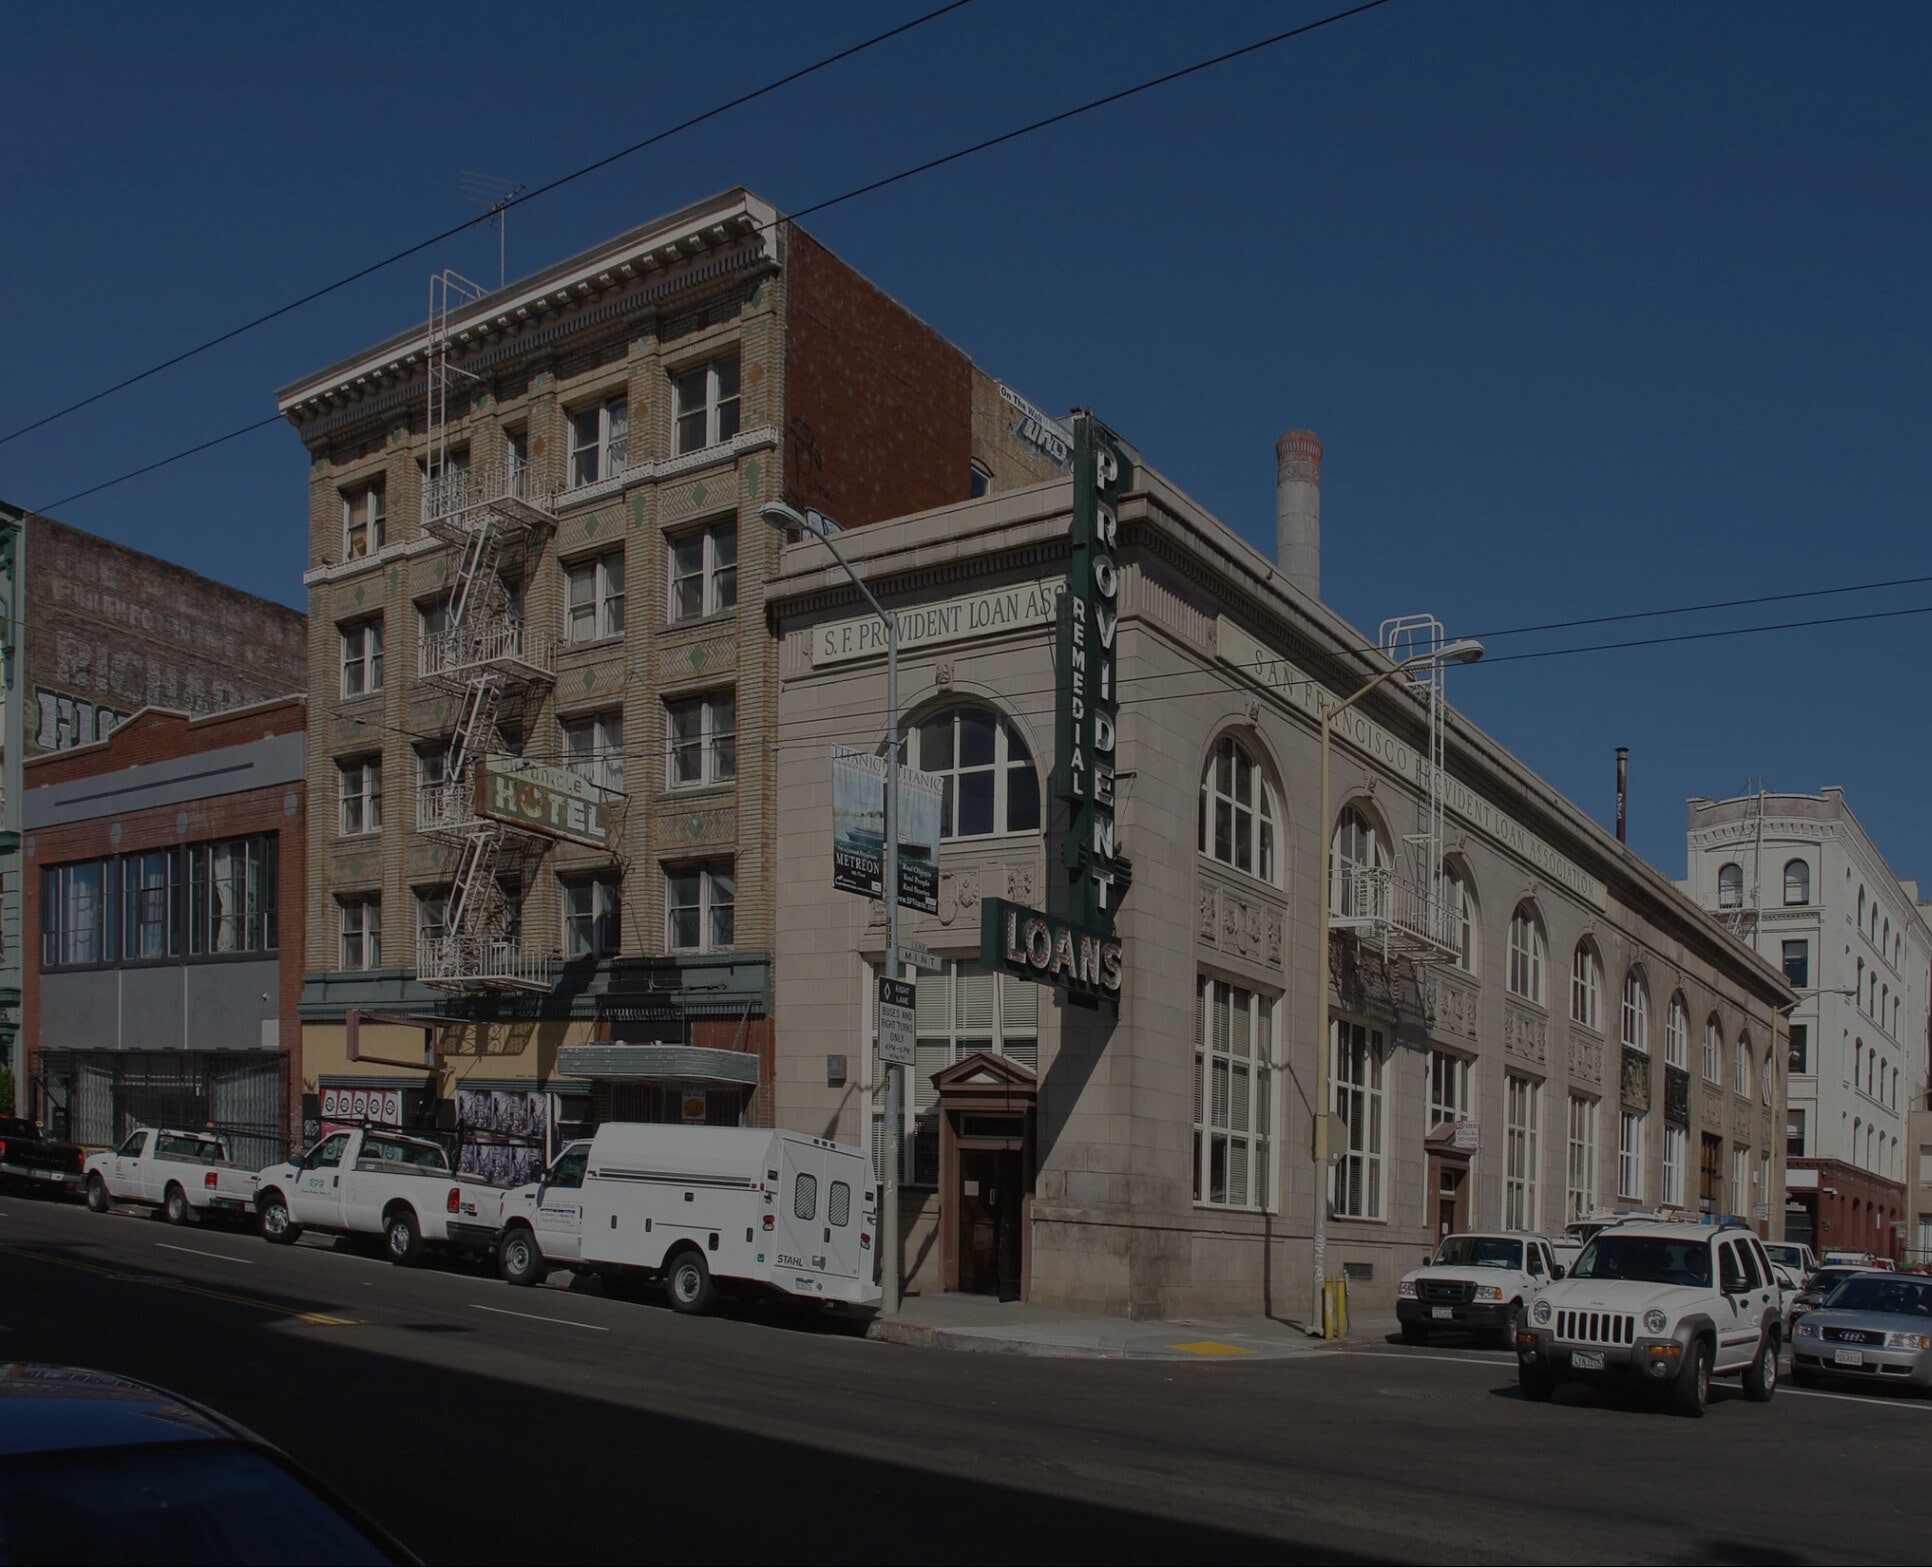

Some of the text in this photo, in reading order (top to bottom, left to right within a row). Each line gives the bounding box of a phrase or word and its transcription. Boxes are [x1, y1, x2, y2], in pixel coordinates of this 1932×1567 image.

[858, 604, 962, 650] PROVIDENT
[969, 592, 1022, 630] LOAN
[1091, 441, 1119, 910] PROVIDENT
[1071, 596, 1087, 796] REMEDIAL
[1254, 648, 1595, 899] SAN FRANCISCO PROVIDENT LOAN ASSOCIATION
[495, 776, 606, 838] HOTEL
[835, 852, 880, 875] METREON
[904, 951, 935, 967] MINT
[1007, 910, 1123, 991] LOANS
[881, 1018, 913, 1034] RIGHT TURNS
[882, 1006, 912, 1021] BUSES AND
[889, 1032, 904, 1043] ONLY
[777, 1254, 803, 1267] STAHL
